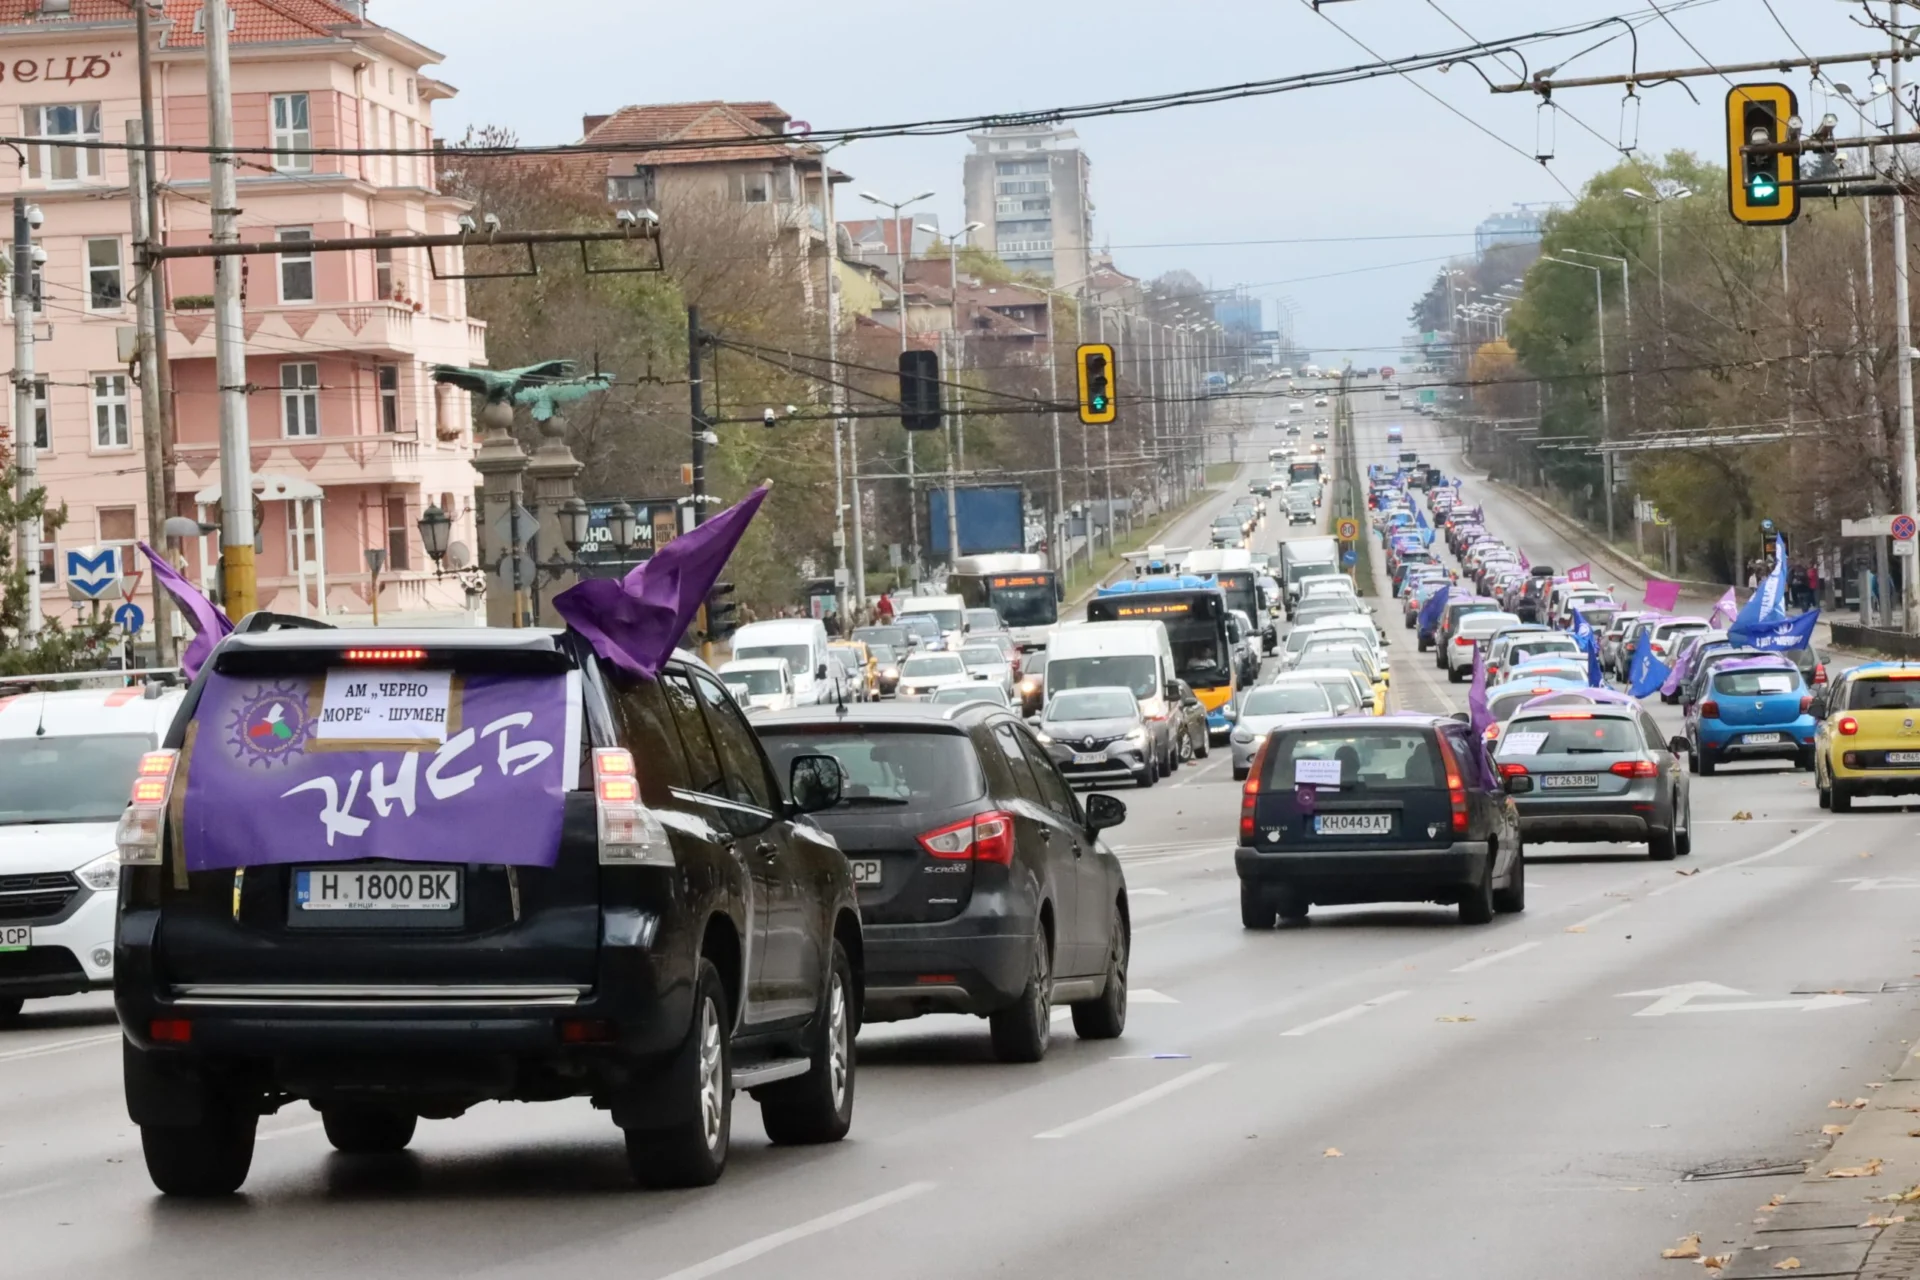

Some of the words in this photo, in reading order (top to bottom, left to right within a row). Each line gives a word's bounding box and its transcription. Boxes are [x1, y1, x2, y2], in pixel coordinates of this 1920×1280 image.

[344, 683, 368, 698] АМ
[322, 707, 371, 723] МОРЕ“
[388, 707, 446, 723] ШУМЕН
[280, 711, 554, 847] КНСБ
[1341, 816, 1371, 829] 0443
[355, 874, 414, 900] 1800
[298, 891, 309, 899] BG
